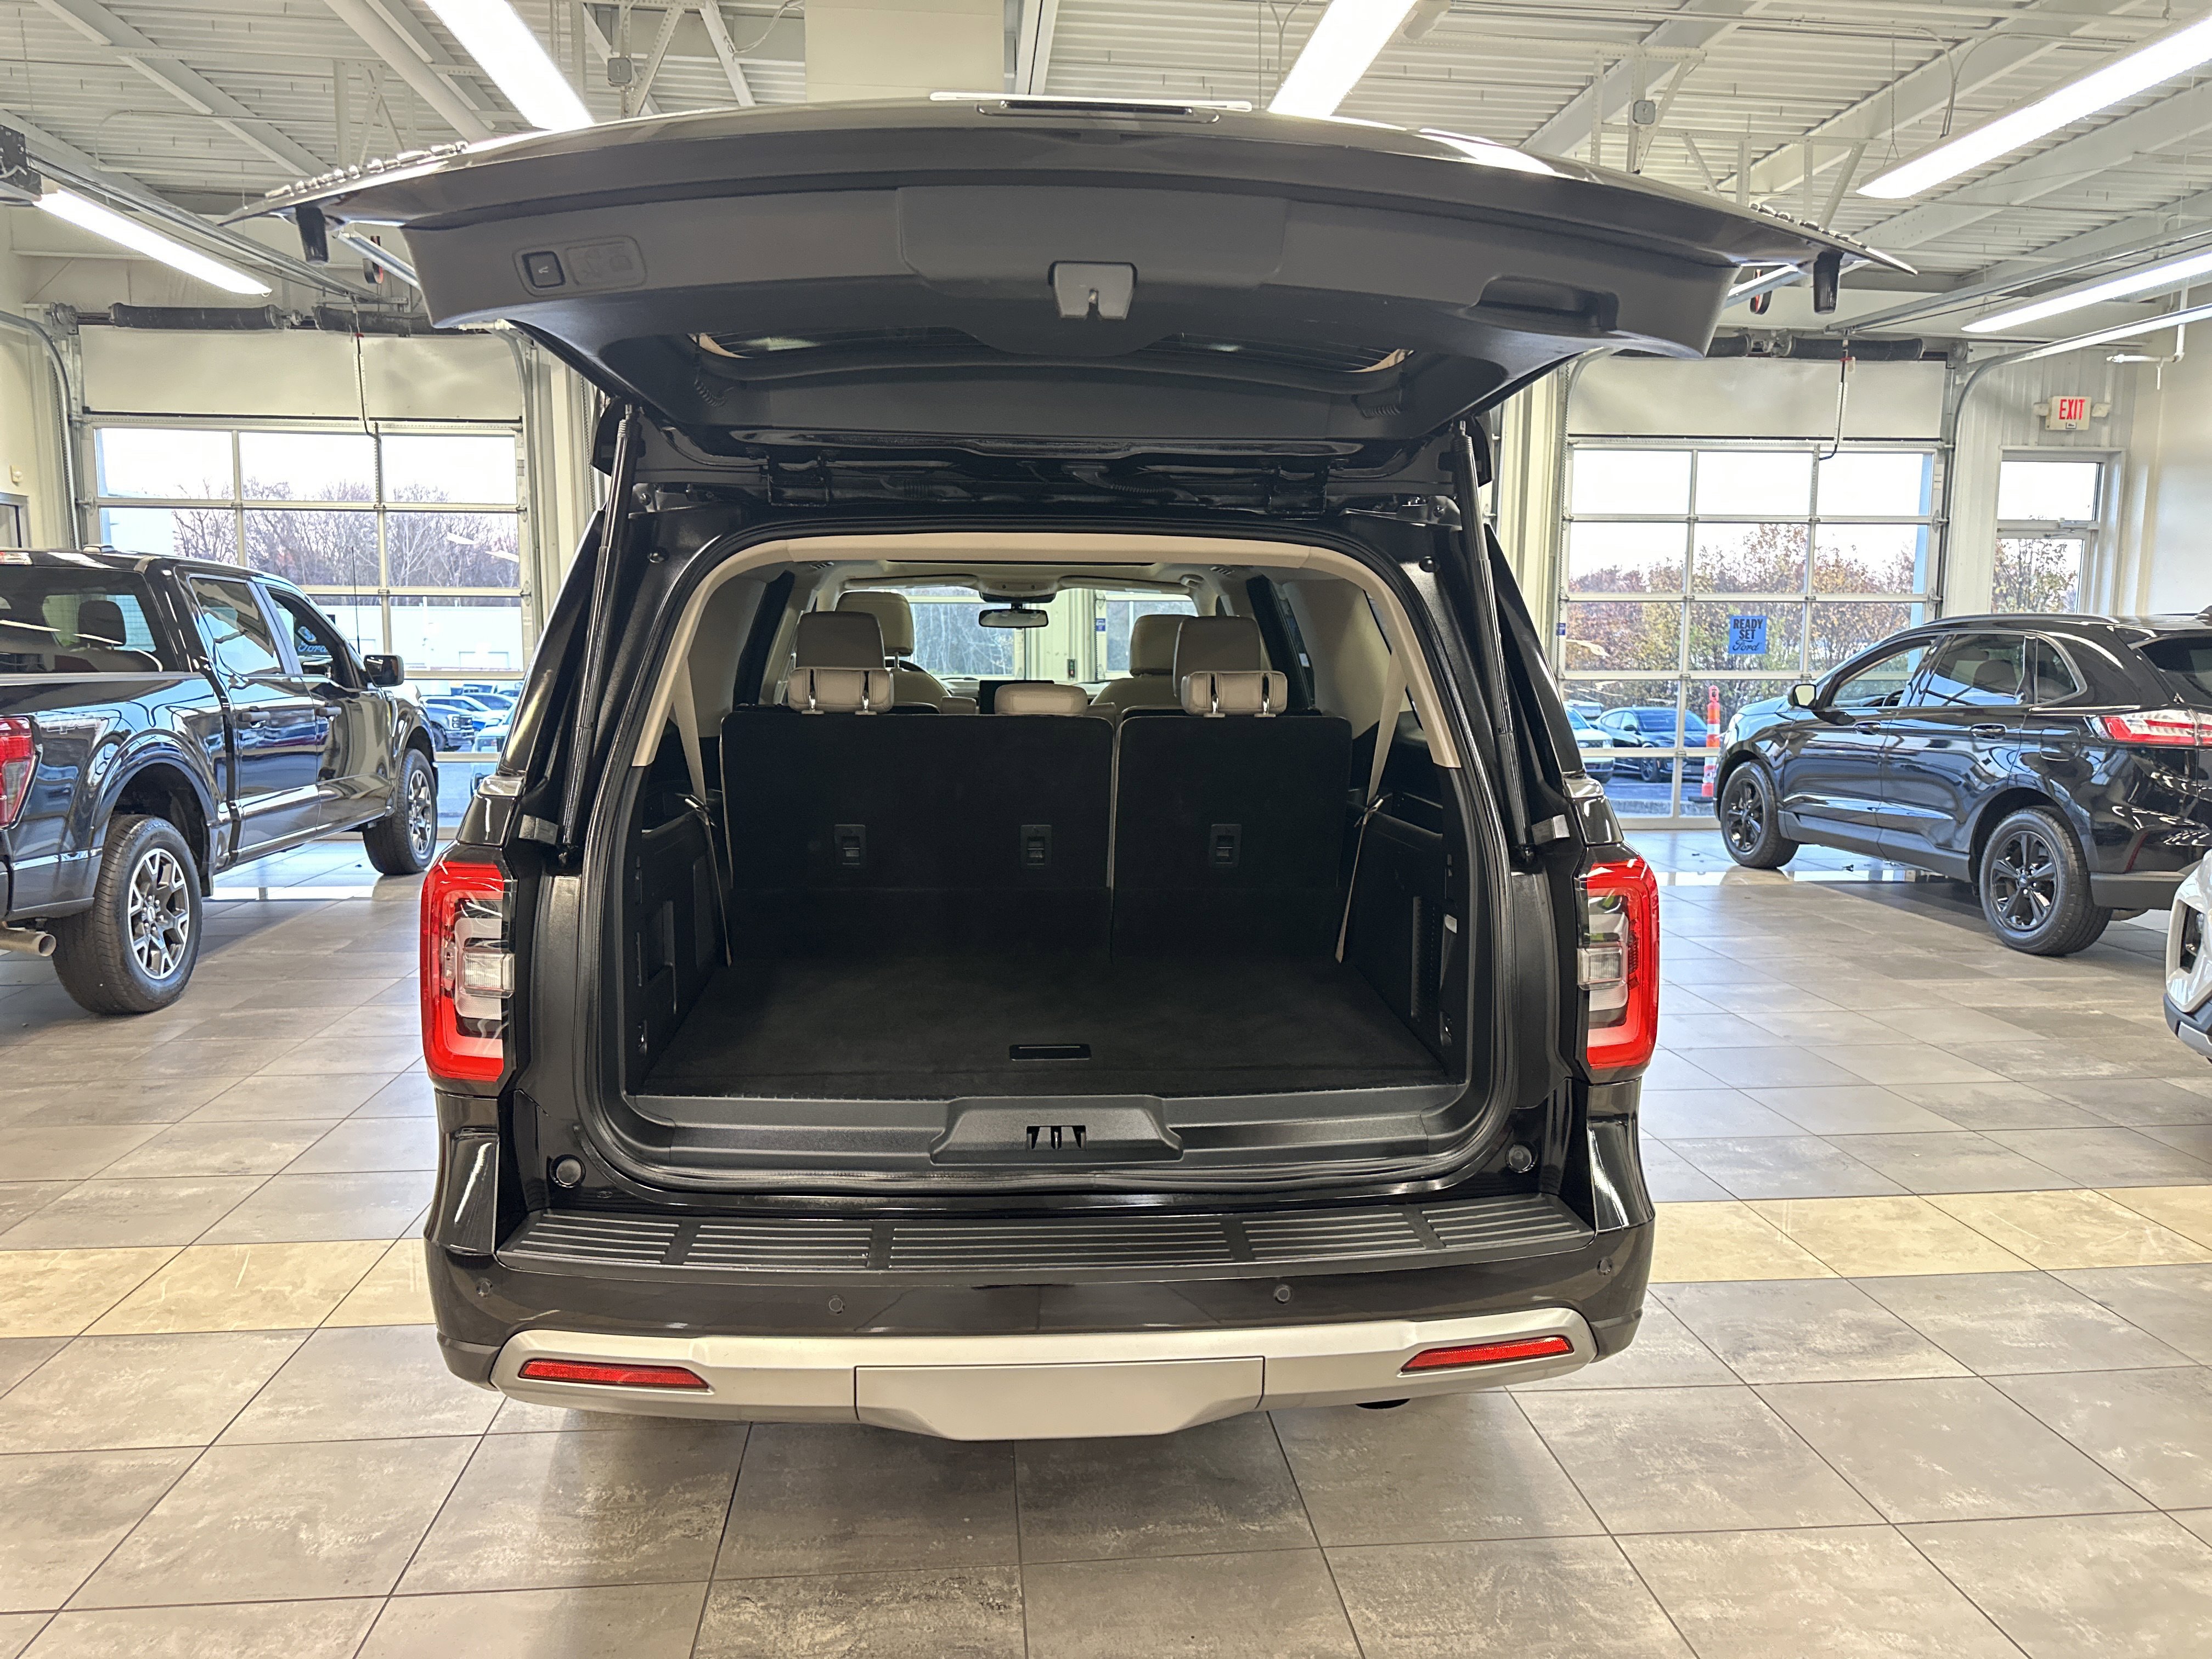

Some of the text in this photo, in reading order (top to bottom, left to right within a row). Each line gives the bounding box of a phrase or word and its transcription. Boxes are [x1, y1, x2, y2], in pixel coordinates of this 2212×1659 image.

[2059, 399, 2085, 420] EXIT
[1733, 619, 1763, 629] READY
[1739, 629, 1756, 639] SET
[1733, 639, 1759, 651] Ford
